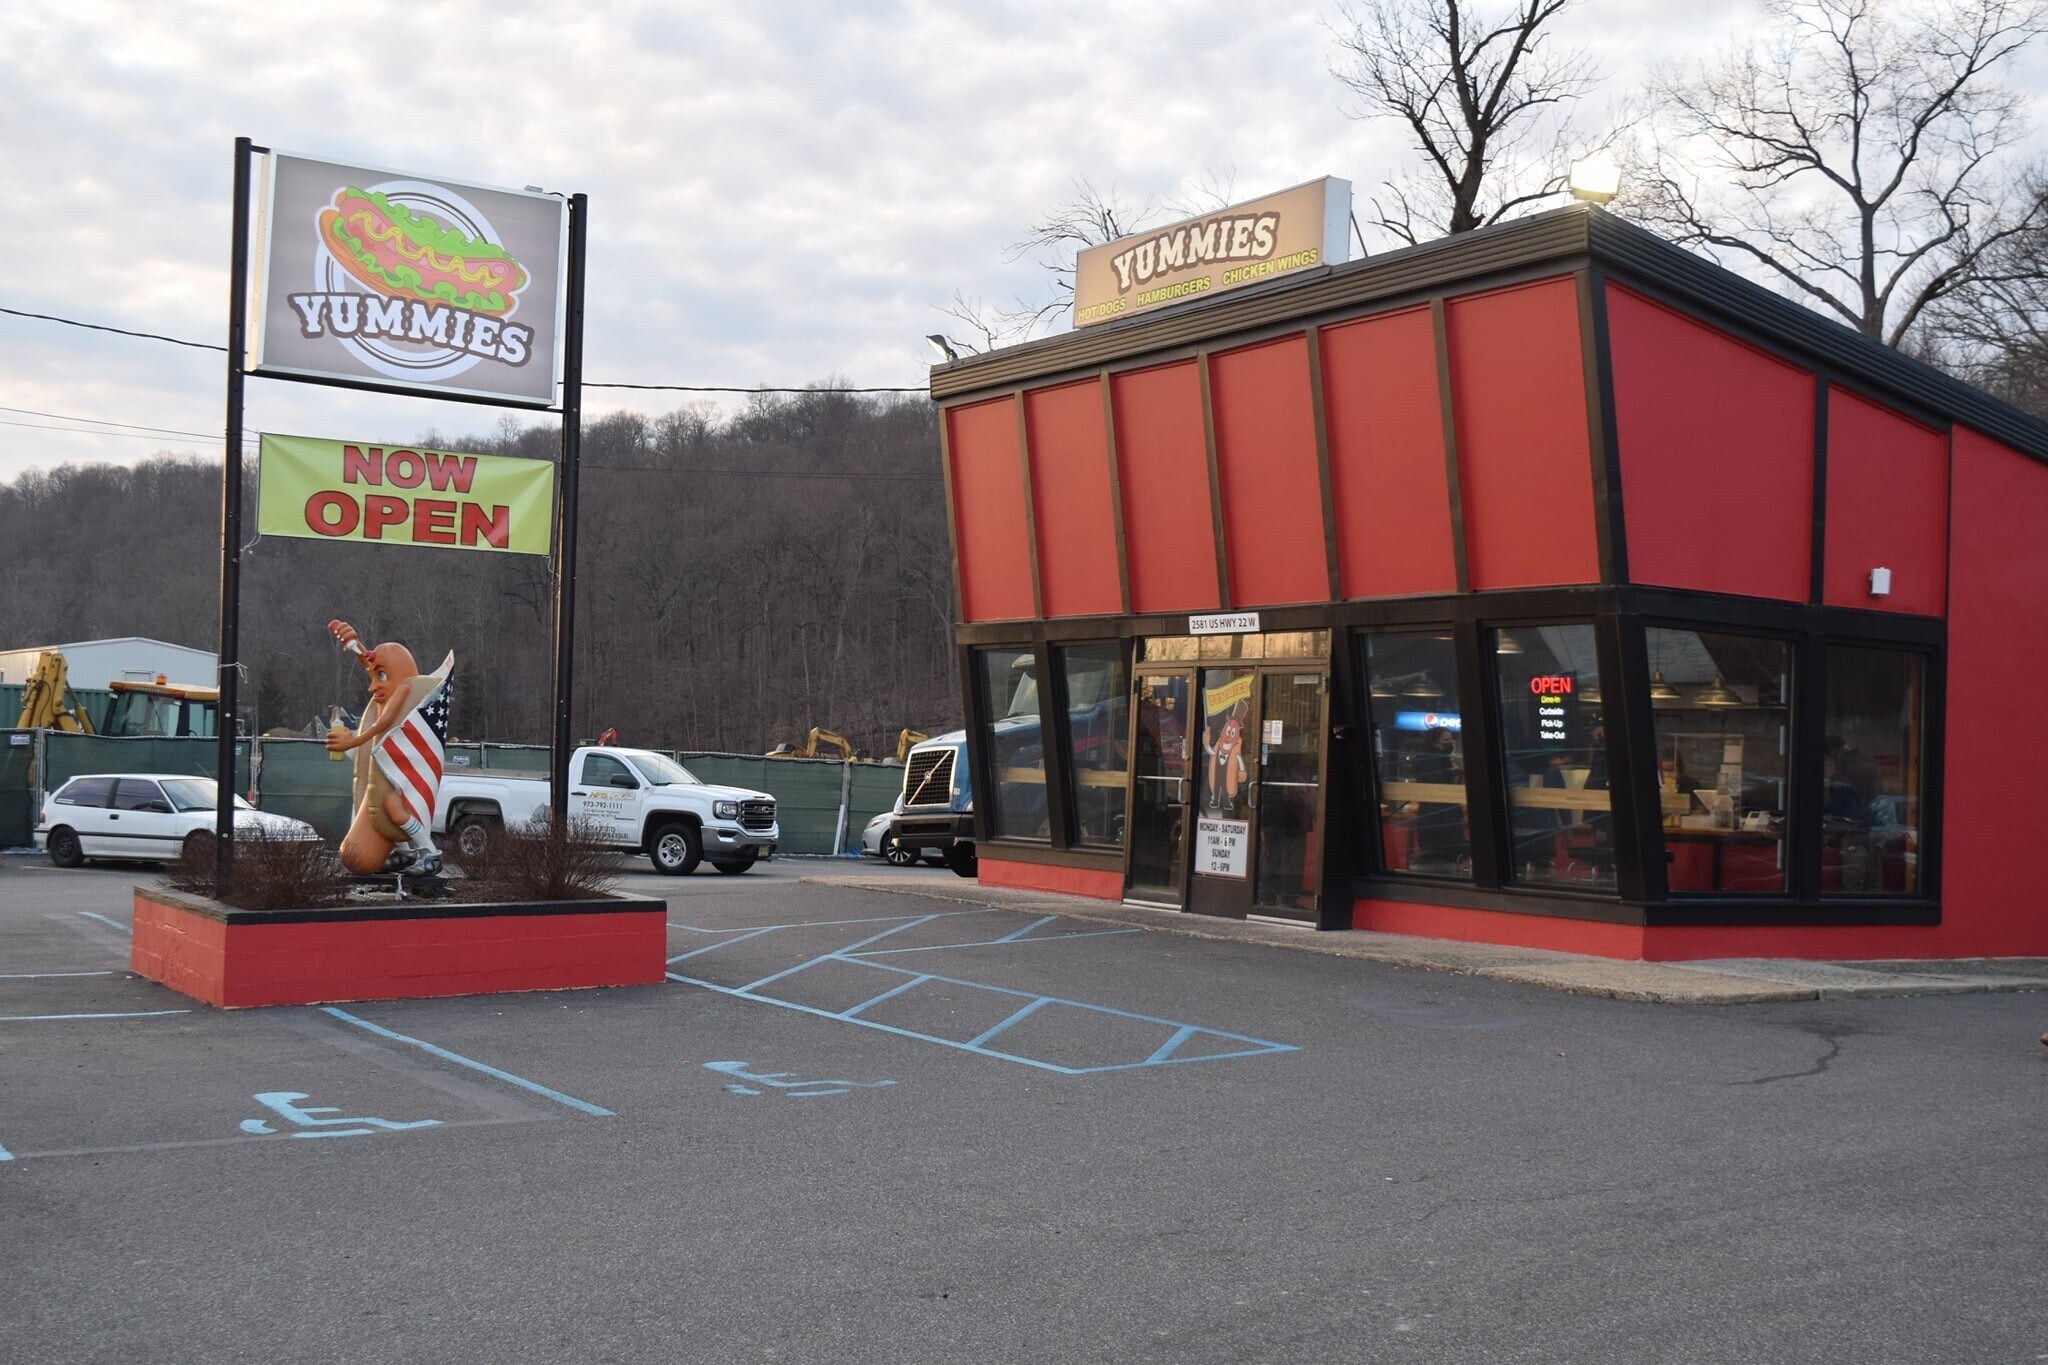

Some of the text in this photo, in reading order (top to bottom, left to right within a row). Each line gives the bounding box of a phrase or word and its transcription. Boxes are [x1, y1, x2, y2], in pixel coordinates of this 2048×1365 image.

[1112, 214, 1279, 292] YUMMIES
[1077, 248, 1319, 322] HOT DOGS HAMBURGERS CHICKEN WINGS
[290, 293, 532, 365] YUMMIES
[343, 445, 478, 494] NOW
[304, 490, 510, 550] OPEN
[1191, 617, 1256, 630] 2581 US HWY 22 W
[1530, 677, 1572, 695] OPEN
[1540, 731, 1566, 740] Take-Out
[1200, 822, 1218, 833] MONDAY
[1221, 823, 1247, 835] SATURDAY
[1207, 835, 1220, 846] 11AM
[1228, 837, 1236, 847] PM
[1211, 848, 1231, 859] SUNDAY
[1211, 861, 1217, 871] 12
